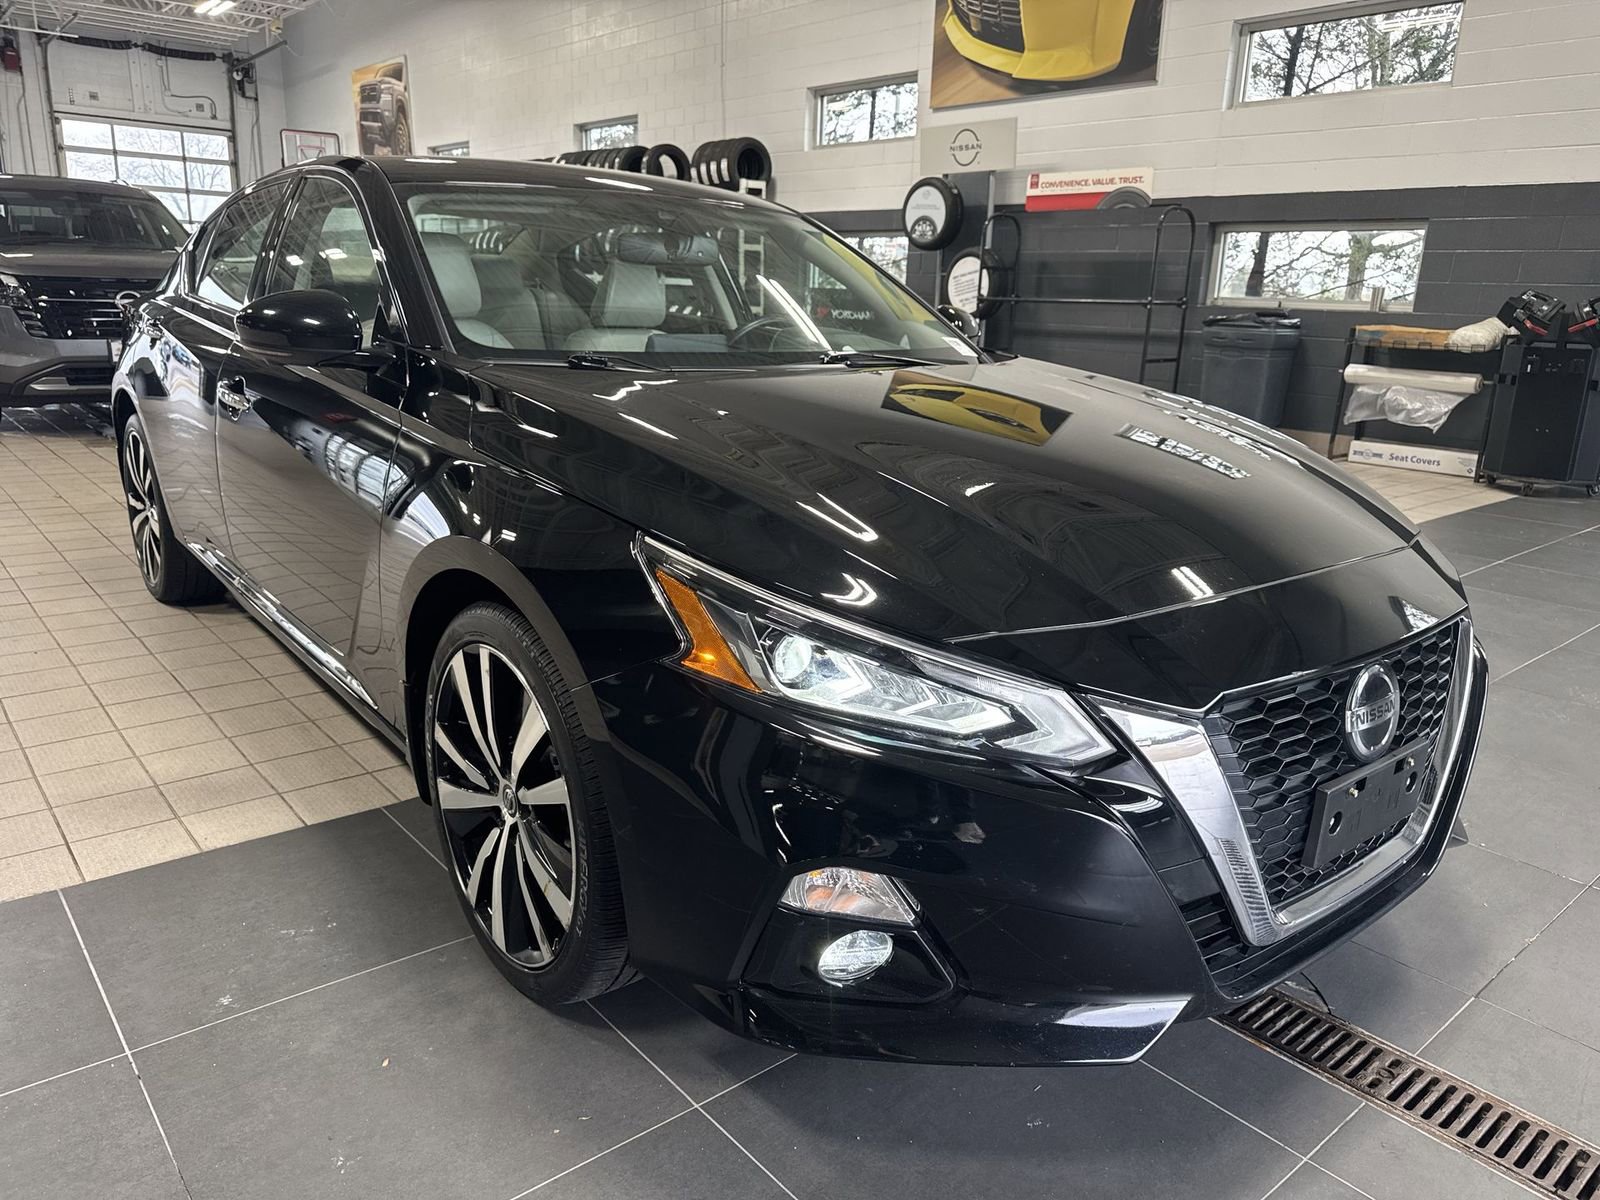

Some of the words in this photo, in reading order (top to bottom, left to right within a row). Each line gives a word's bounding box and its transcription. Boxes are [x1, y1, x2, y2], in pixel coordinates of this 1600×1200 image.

[949, 143, 983, 152] NISSAN
[1041, 179, 1090, 189] CONVENIENCE.
[1118, 176, 1144, 184] TRUST.
[1389, 453, 1409, 462] Seat
[1410, 455, 1441, 466] Covers
[1356, 700, 1395, 725] NISSAN
[576, 817, 589, 919] KINERGY
